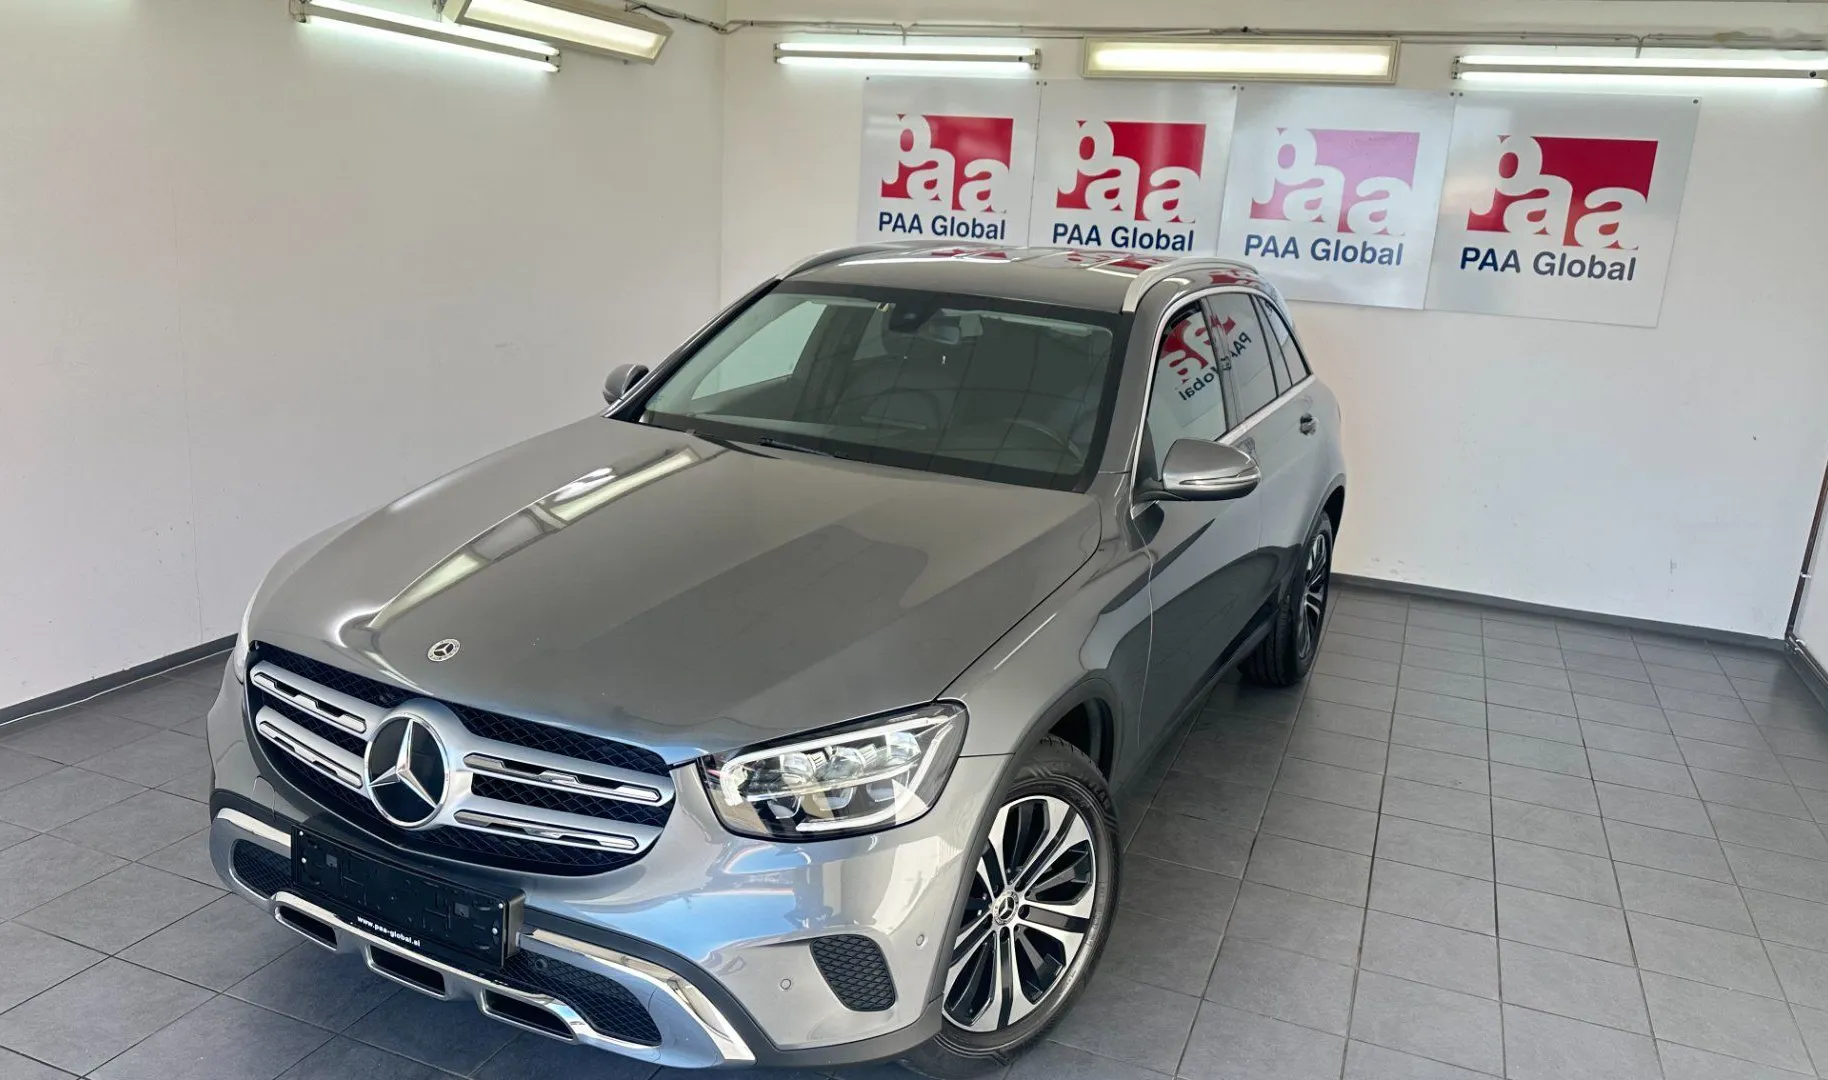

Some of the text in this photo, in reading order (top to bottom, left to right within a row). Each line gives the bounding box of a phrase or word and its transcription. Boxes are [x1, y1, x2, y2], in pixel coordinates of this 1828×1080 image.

[878, 211, 1006, 240] PAA Global
[1052, 222, 1195, 252] PAA Global
[1244, 234, 1404, 266] PAA Global
[1459, 246, 1637, 281] PAA Global
